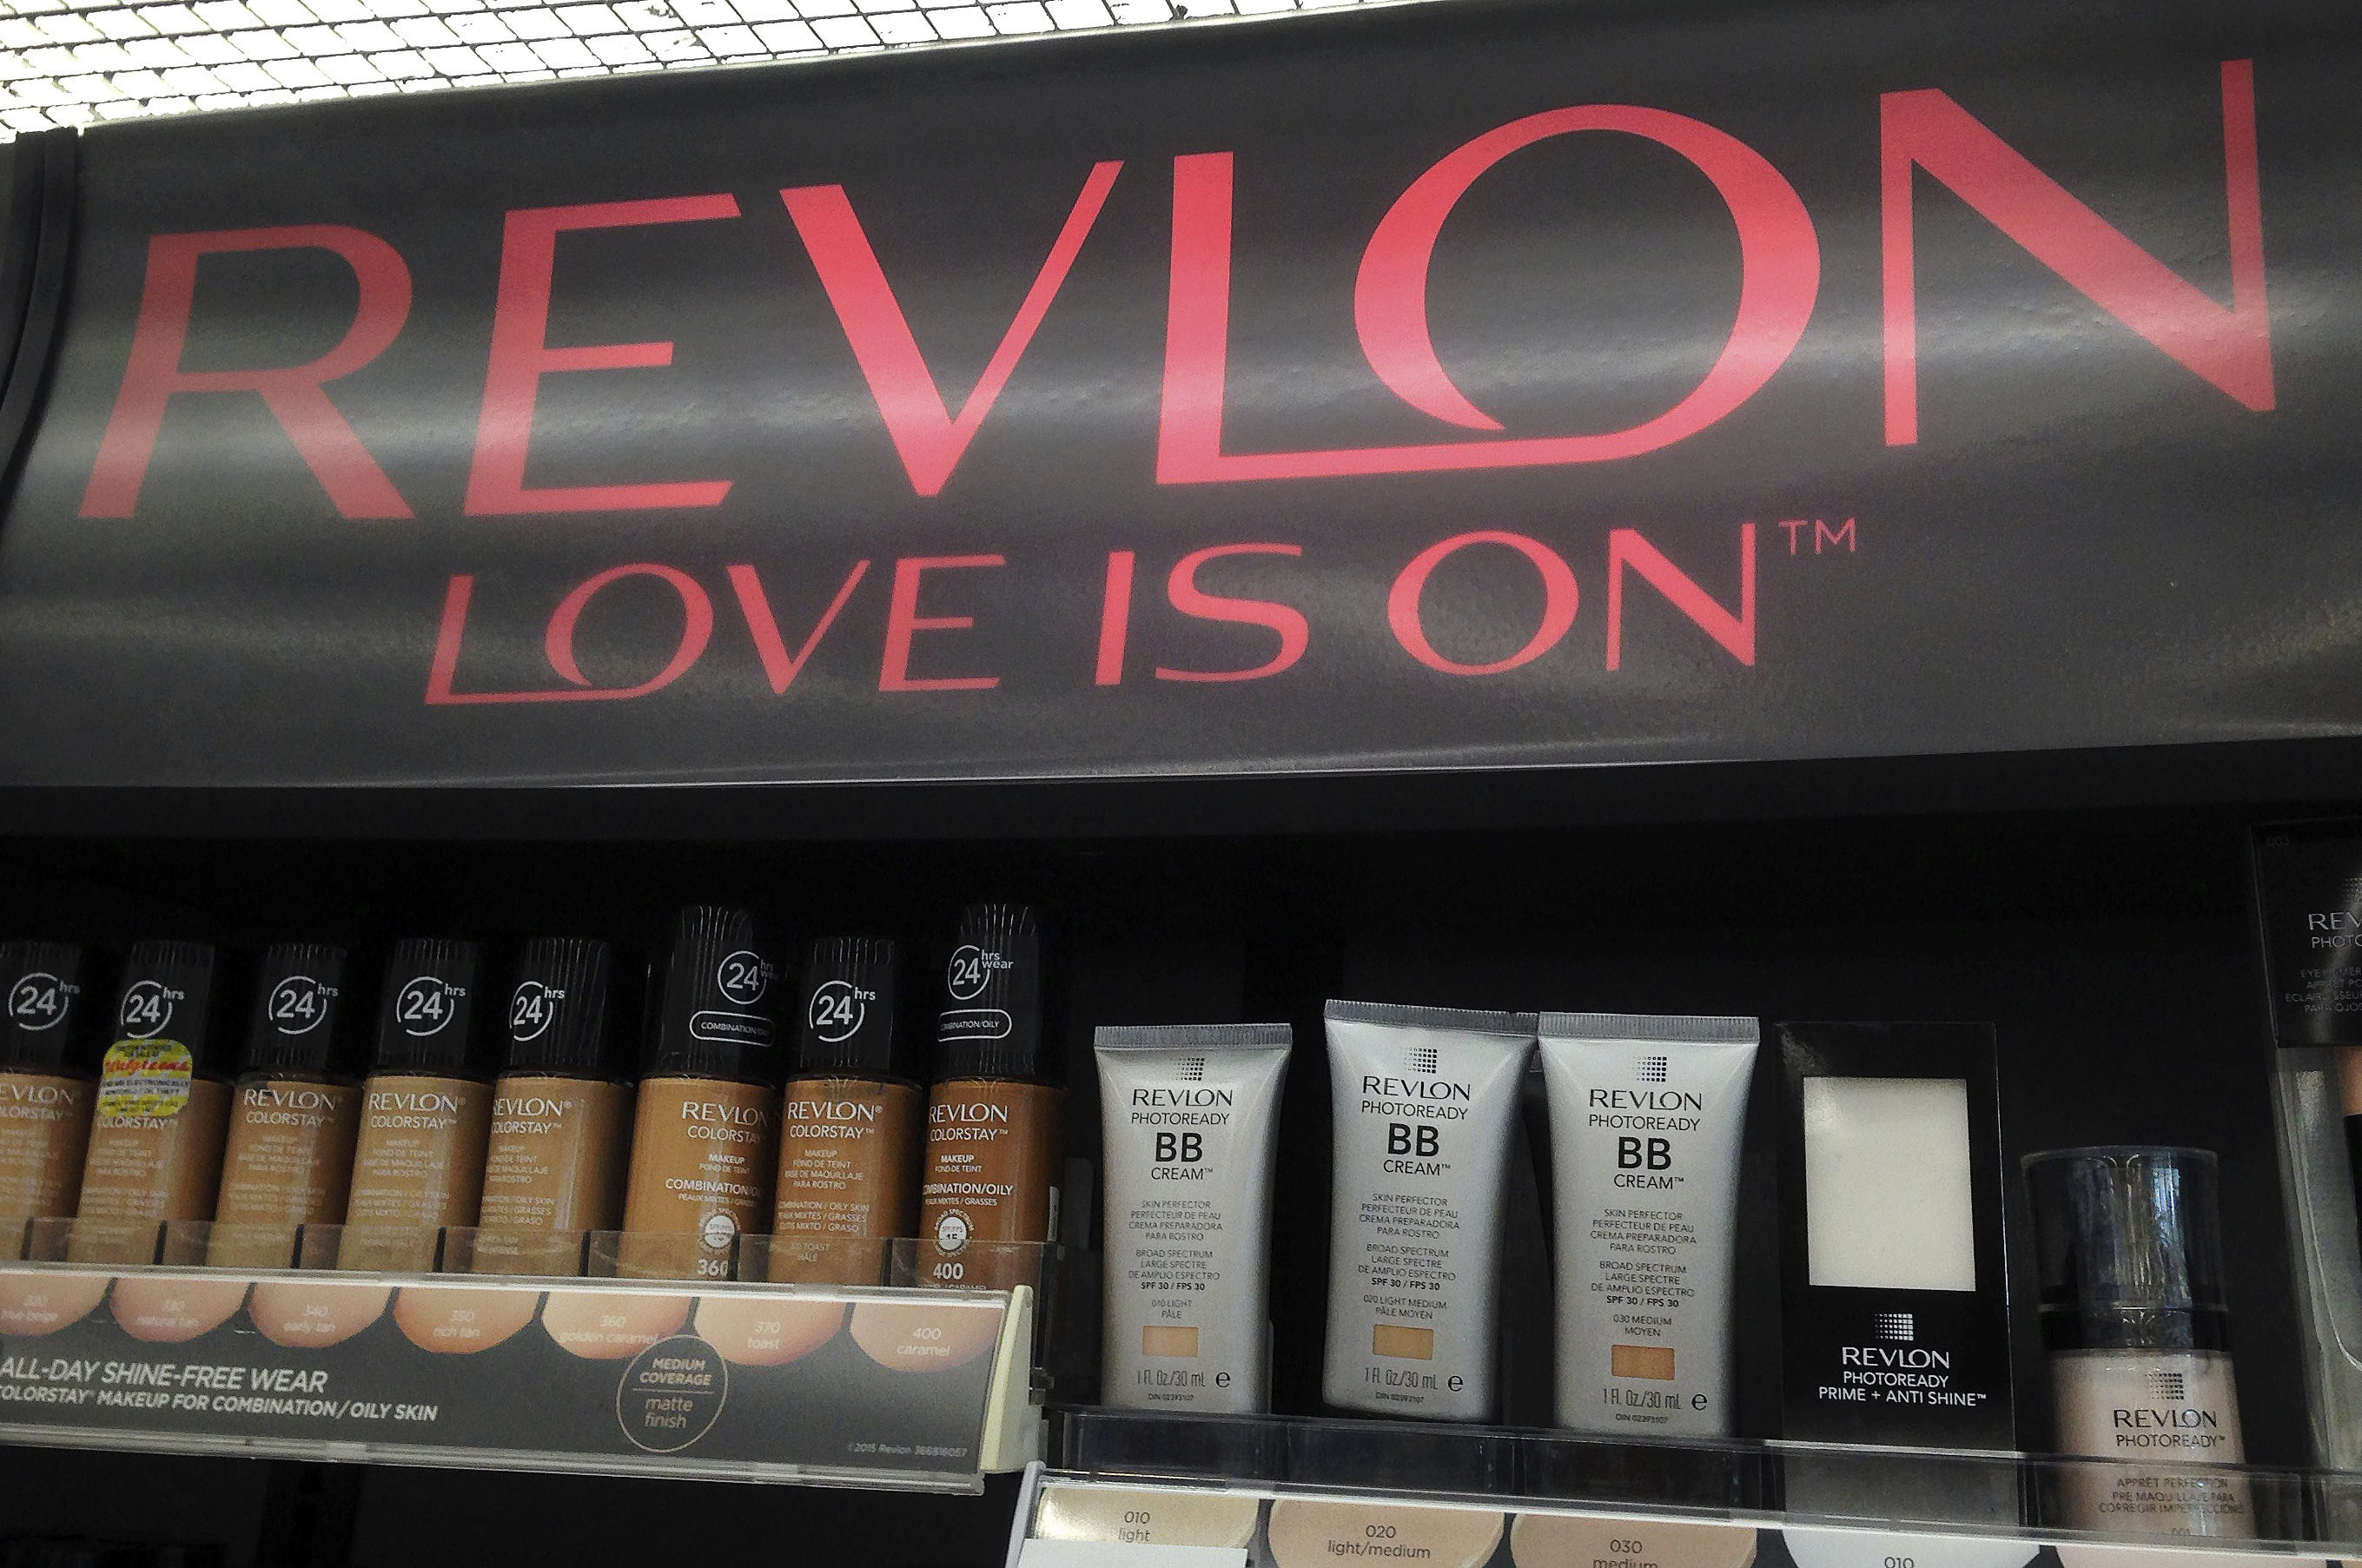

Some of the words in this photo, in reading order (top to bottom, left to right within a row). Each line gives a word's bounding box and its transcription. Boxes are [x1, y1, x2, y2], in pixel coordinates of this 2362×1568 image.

[78, 59, 2276, 521] REVLON
[423, 553, 1007, 705] LOVE
[1095, 544, 1309, 685] IS
[1388, 524, 1756, 676] ON
[2308, 912, 2362, 931] REV
[2311, 934, 2362, 949] PHOTO
[953, 958, 981, 986] 24
[981, 949, 1000, 961] hrs
[982, 960, 1014, 970] wear
[726, 963, 759, 991] 24
[17, 987, 57, 1015] 24
[59, 980, 80, 995] hrs
[126, 995, 162, 1022] 24
[163, 986, 185, 1002] hrs
[277, 989, 315, 1018] 24
[317, 982, 339, 997] hrs
[404, 991, 443, 1020] 24
[444, 982, 466, 997] hrs
[513, 996, 543, 1025] 24
[544, 986, 565, 1000] hrs
[817, 996, 853, 1025] 24
[854, 987, 877, 1001] hrs
[0, 1084, 73, 1106] EVLON
[1362, 1075, 1472, 1102] REVLON
[1132, 1088, 1234, 1108] REVLON
[1589, 1088, 1703, 1112] REVLON
[929, 1103, 1009, 1123] REVLON
[1361, 1100, 1469, 1121] PHOTOREADY
[1131, 1112, 1230, 1126] PHOTOREADY
[1589, 1114, 1701, 1131] PHOTOREADY
[1387, 1122, 1440, 1157] BB
[804, 1149, 837, 1159] MAKEUP
[1155, 1132, 1203, 1163] BB
[1618, 1135, 1672, 1170] BB
[708, 1154, 745, 1165] MAKEUP
[941, 1154, 975, 1164] MAKEUP
[1141, 1200, 1161, 1209] SKIN
[1161, 1201, 1211, 1209] PERFECTOR
[1373, 1193, 1393, 1202] SKIN
[1395, 1194, 1448, 1207] PERFECTOR
[1131, 1211, 1183, 1221] PERFECTEUR
[1199, 1212, 1221, 1221] PEAU
[1361, 1203, 1419, 1216] PERFECTEUR
[1433, 1208, 1459, 1219] PEAU
[1604, 1208, 1626, 1218] SKIN
[1628, 1210, 1684, 1221] PERFECTOR
[1129, 1221, 1158, 1230] CREMA
[1160, 1221, 1223, 1230] PREPARADORA
[1359, 1214, 1391, 1225] CREMA
[1393, 1216, 1460, 1229] PREPARADORA
[1592, 1219, 1651, 1230] PERFECTEUR
[1669, 1223, 1694, 1234] PEAU
[1169, 1233, 1204, 1241] ROSTRO
[1377, 1226, 1400, 1236] PARA
[1402, 1228, 1439, 1240] ROSTRO
[1590, 1230, 1624, 1241] CREMA
[1626, 1233, 1697, 1244] PREPARADORA
[1168, 1250, 1213, 1259] SPECTRUM
[1366, 1243, 1399, 1254] BROAD
[1400, 1246, 1449, 1258] SPECTRUM
[1610, 1242, 1635, 1253] PARA
[1637, 1245, 1677, 1255] ROSTRO
[697, 1259, 729, 1277] 360
[1141, 1260, 1168, 1269] LARGE
[1170, 1260, 1207, 1269] SPECTRE
[1371, 1255, 1400, 1266] LARGE
[1402, 1257, 1443, 1269] SPECTRE
[1599, 1261, 1633, 1272] BROAD
[1635, 1262, 1687, 1274] SPECTRUM
[933, 1262, 964, 1280] 400
[1141, 1271, 1173, 1280] AMPLIO
[1175, 1272, 1221, 1280] ESPECTRO
[1371, 1266, 1406, 1277] AMPLIO
[1408, 1268, 1457, 1281] ESPECTRO
[1141, 1281, 1157, 1291] SPF
[1159, 1282, 1169, 1291] 30
[1176, 1282, 1192, 1291] FPS
[1194, 1282, 1206, 1291] 30
[1371, 1277, 1388, 1287] SPF
[1390, 1279, 1401, 1287] 30
[1409, 1280, 1426, 1290] FPS
[1429, 1281, 1440, 1291] 30
[1605, 1273, 1637, 1283] LARGE
[1639, 1274, 1680, 1285] SPECTRE
[1606, 1284, 1643, 1294] AMPLIO
[1645, 1287, 1695, 1297] ESPECTRO
[1379, 1295, 1406, 1306] LIGHT
[1408, 1298, 1448, 1310] MEDIUM
[1606, 1294, 1624, 1304] SPF
[1626, 1296, 1638, 1306] 30
[1647, 1298, 1664, 1307] FPS
[1667, 1299, 1679, 1308] 30
[600, 1315, 626, 1329] 360
[1399, 1309, 1433, 1320] MOYEN
[1613, 1313, 1631, 1324] 030
[1631, 1315, 1672, 1326] MEDIUM
[755, 1321, 781, 1334] 370
[911, 1327, 942, 1340] 400
[1624, 1327, 1661, 1337] MOYEN
[897, 1345, 951, 1357] caramel
[1842, 1346, 1950, 1369] REVLON
[652, 1358, 706, 1371] MEDIUM
[1, 1357, 101, 1382] ALL-DAY
[101, 1360, 246, 1390] SHINE-FREE
[250, 1368, 328, 1393] WEAR
[638, 1372, 712, 1386] COVERAGE
[1843, 1371, 1949, 1388] PHOTOREADY
[1818, 1386, 1866, 1401] PRIME
[1886, 1389, 1923, 1404] ANTI
[96, 1389, 171, 1408] MAKEUP
[173, 1393, 209, 1411] FOR
[394, 1404, 439, 1421] SKIN
[645, 1397, 693, 1413] matte
[645, 1413, 687, 1429] finish
[2114, 1409, 2218, 1428] REVLON
[1124, 1511, 1151, 1525] 010
[1118, 1527, 1151, 1543] light
[1365, 1525, 1396, 1538] 020
[1327, 1539, 1432, 1560] light/medium
[1610, 1539, 1643, 1554] 030
[1592, 1557, 1659, 1568] medium
